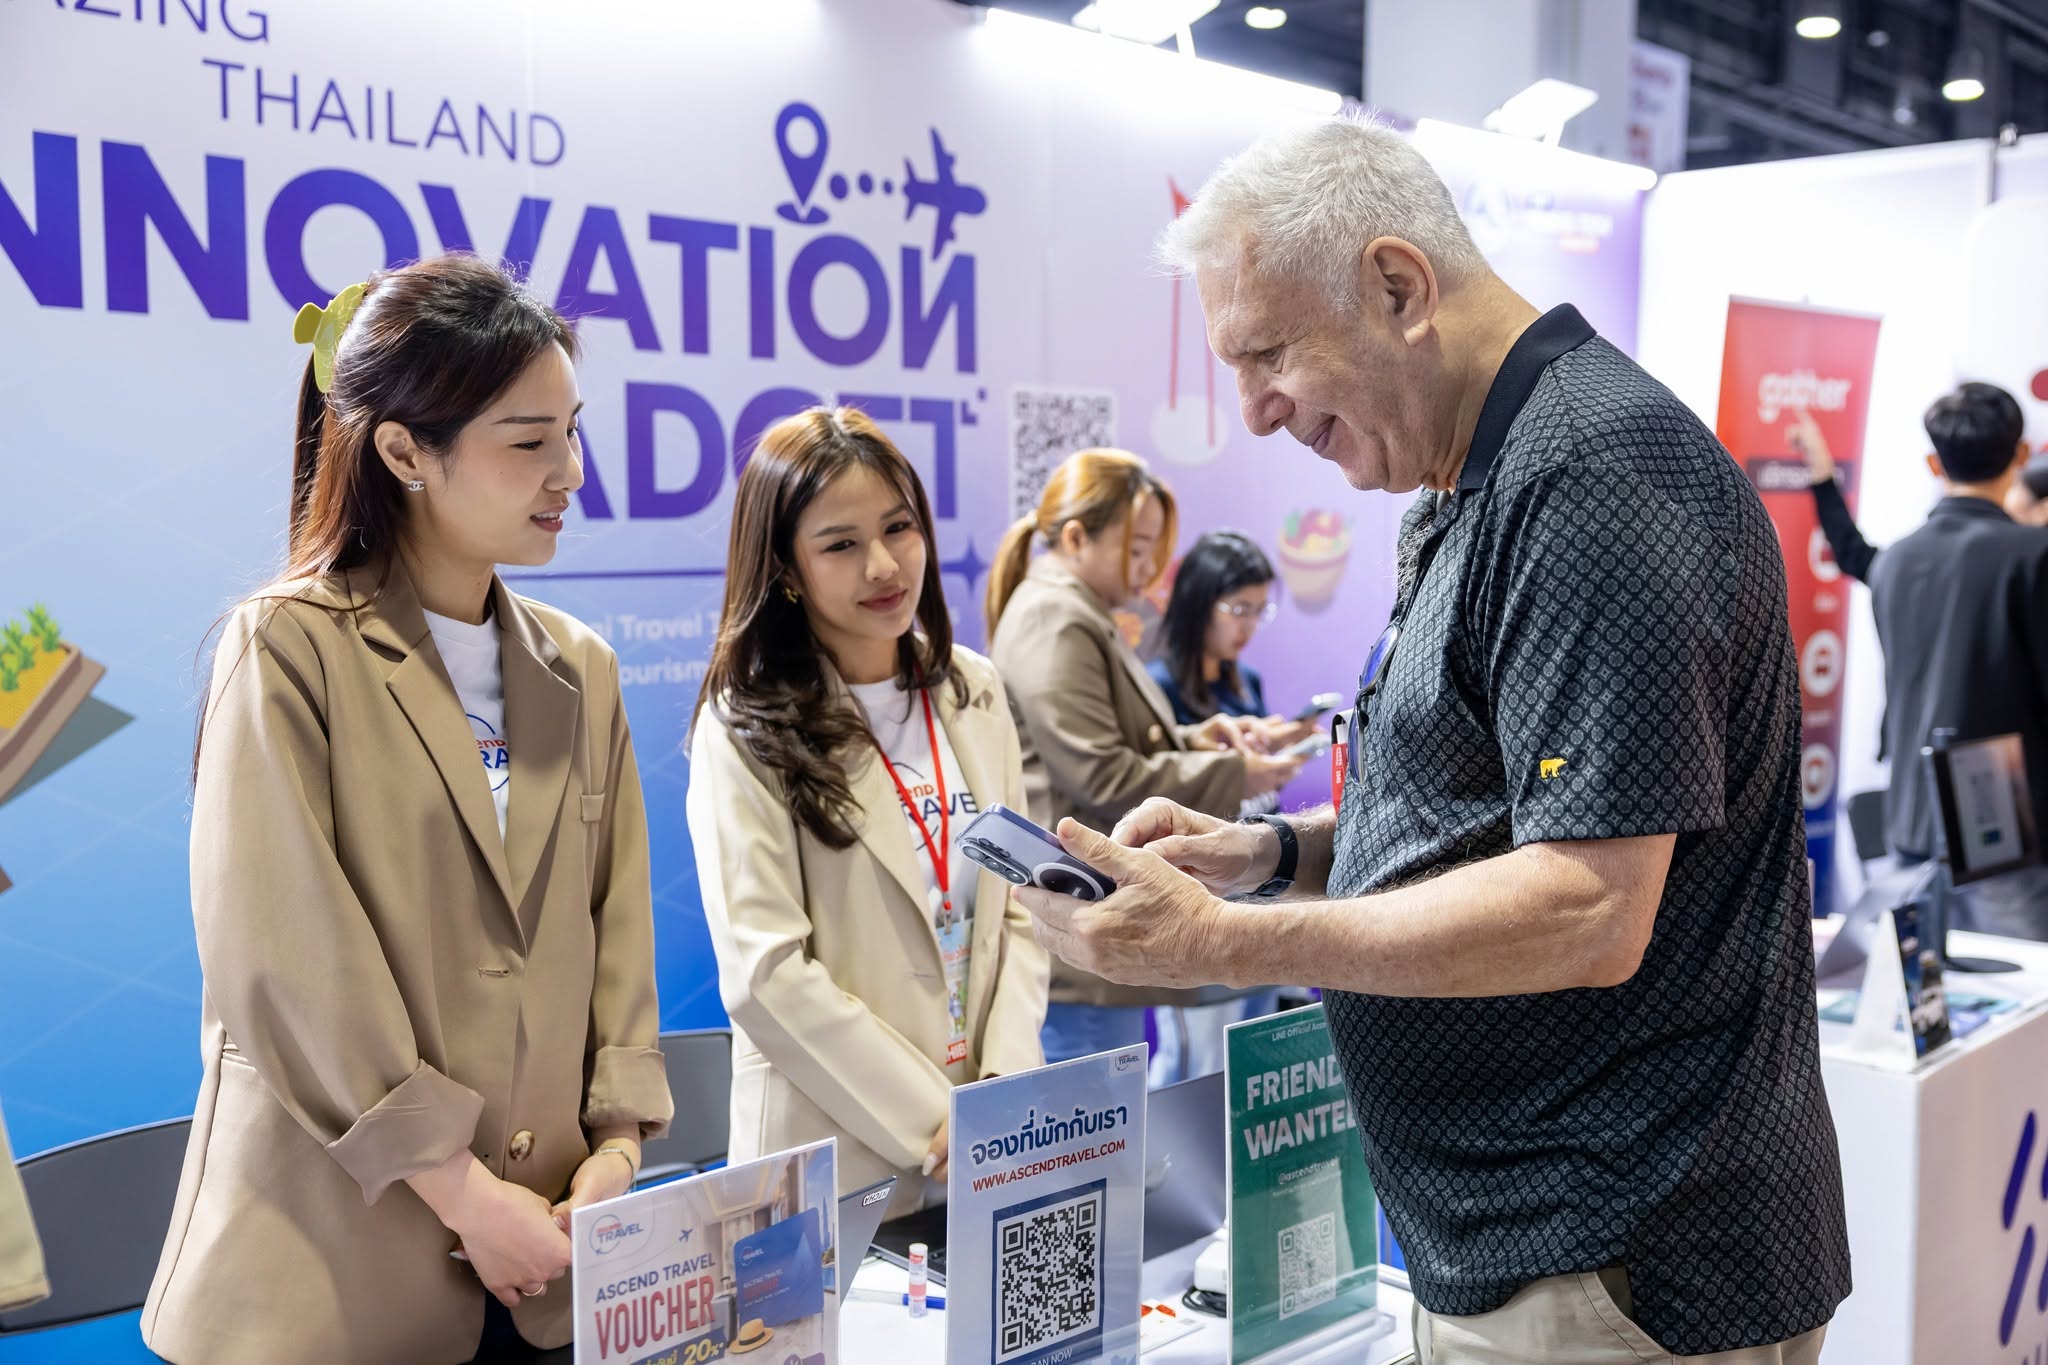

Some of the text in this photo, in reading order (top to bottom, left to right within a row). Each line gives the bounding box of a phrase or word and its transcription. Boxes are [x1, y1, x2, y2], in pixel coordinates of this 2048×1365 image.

[202, 58, 567, 167] THAILAND
[617, 612, 703, 642] Travel
[1272, 1031, 1287, 1042] LINE
[971, 1105, 1127, 1165] จองที่พักกับเรา
[972, 1139, 1125, 1193] WWW.ASCENDTRAVEL.COM
[597, 1223, 644, 1245] TRAVEL
[596, 1252, 716, 1303] ASCEND TRAVEL
[594, 1275, 716, 1360] VOUCHER
[1051, 1347, 1073, 1365] NOW
